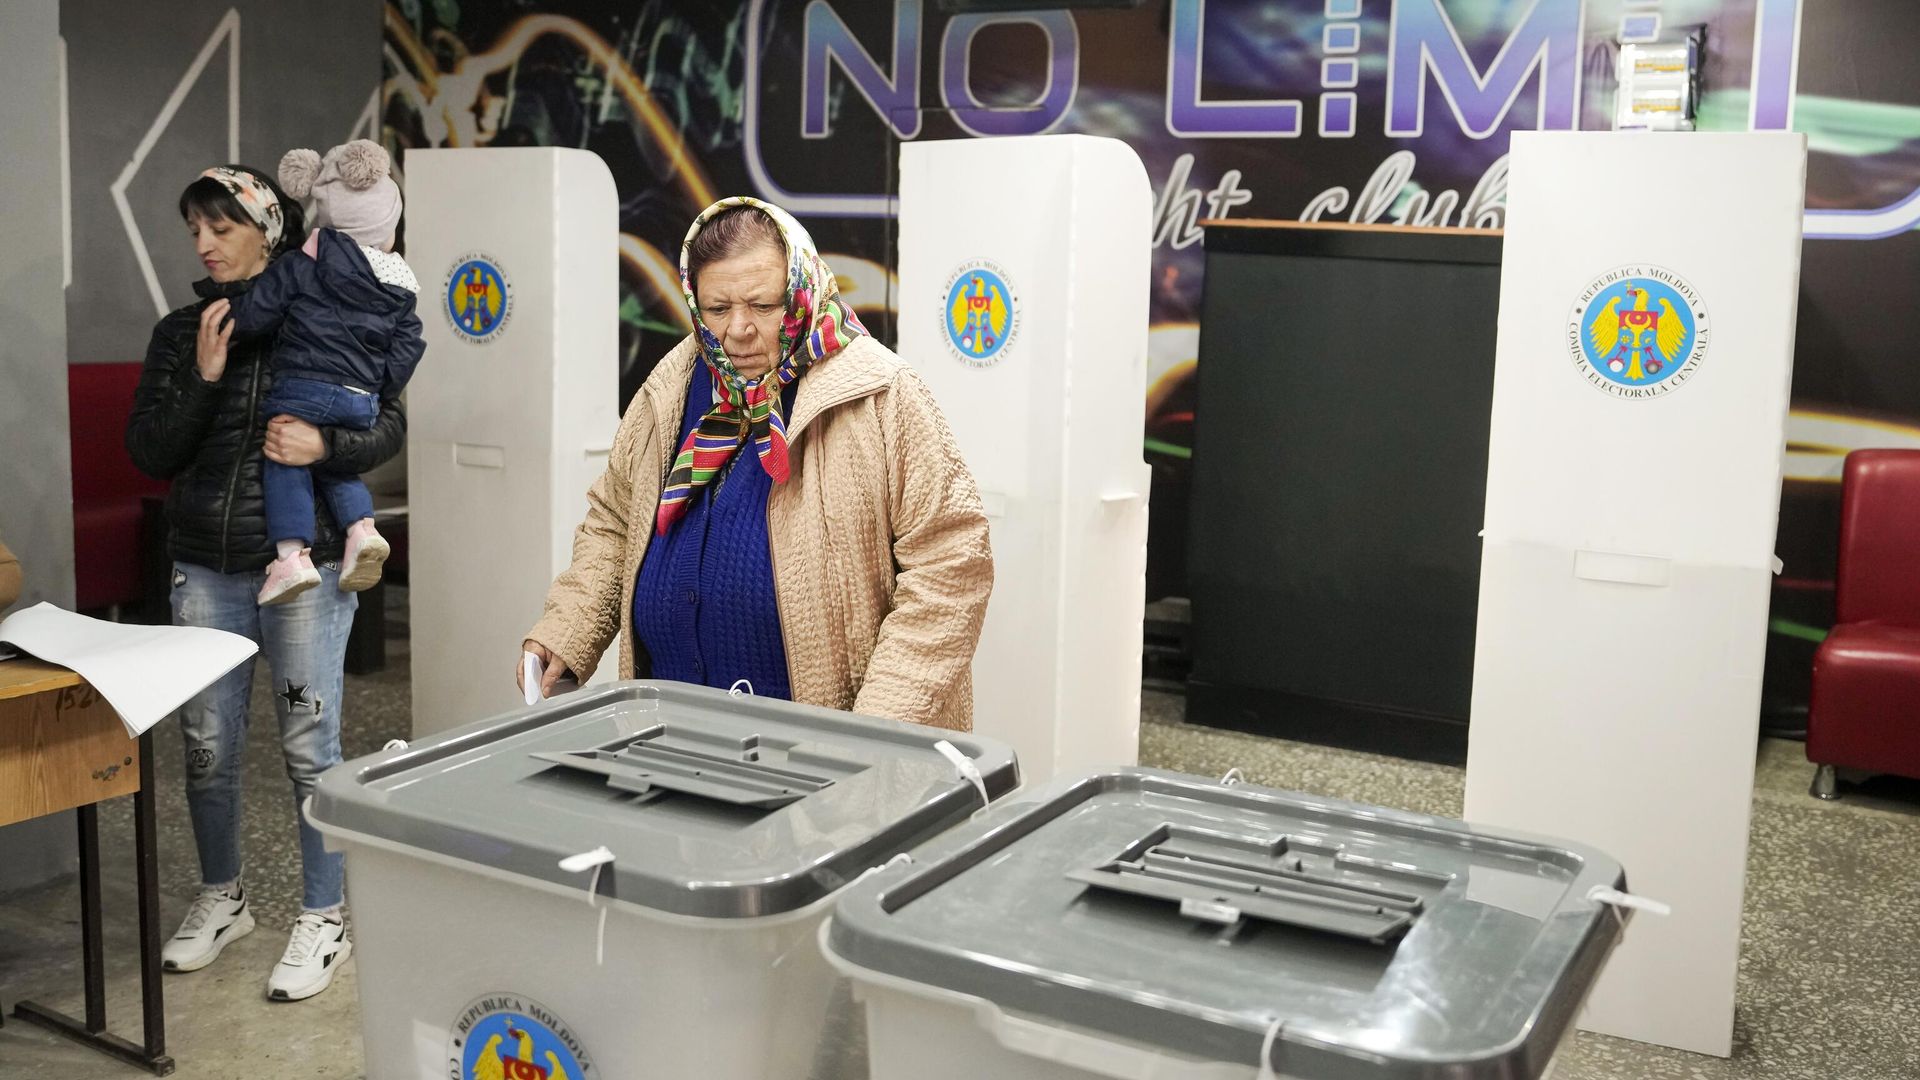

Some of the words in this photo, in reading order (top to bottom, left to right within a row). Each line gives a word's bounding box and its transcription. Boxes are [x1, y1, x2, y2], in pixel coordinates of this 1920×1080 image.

[801, 0, 1080, 140] NO
[1580, 268, 1642, 303] REPUBLICA
[1648, 268, 1698, 306] MOLDOVA
[1569, 322, 1587, 372] COMISIA
[458, 997, 522, 1034] REPUBLICA
[530, 1004, 590, 1071] MOLDOVA
